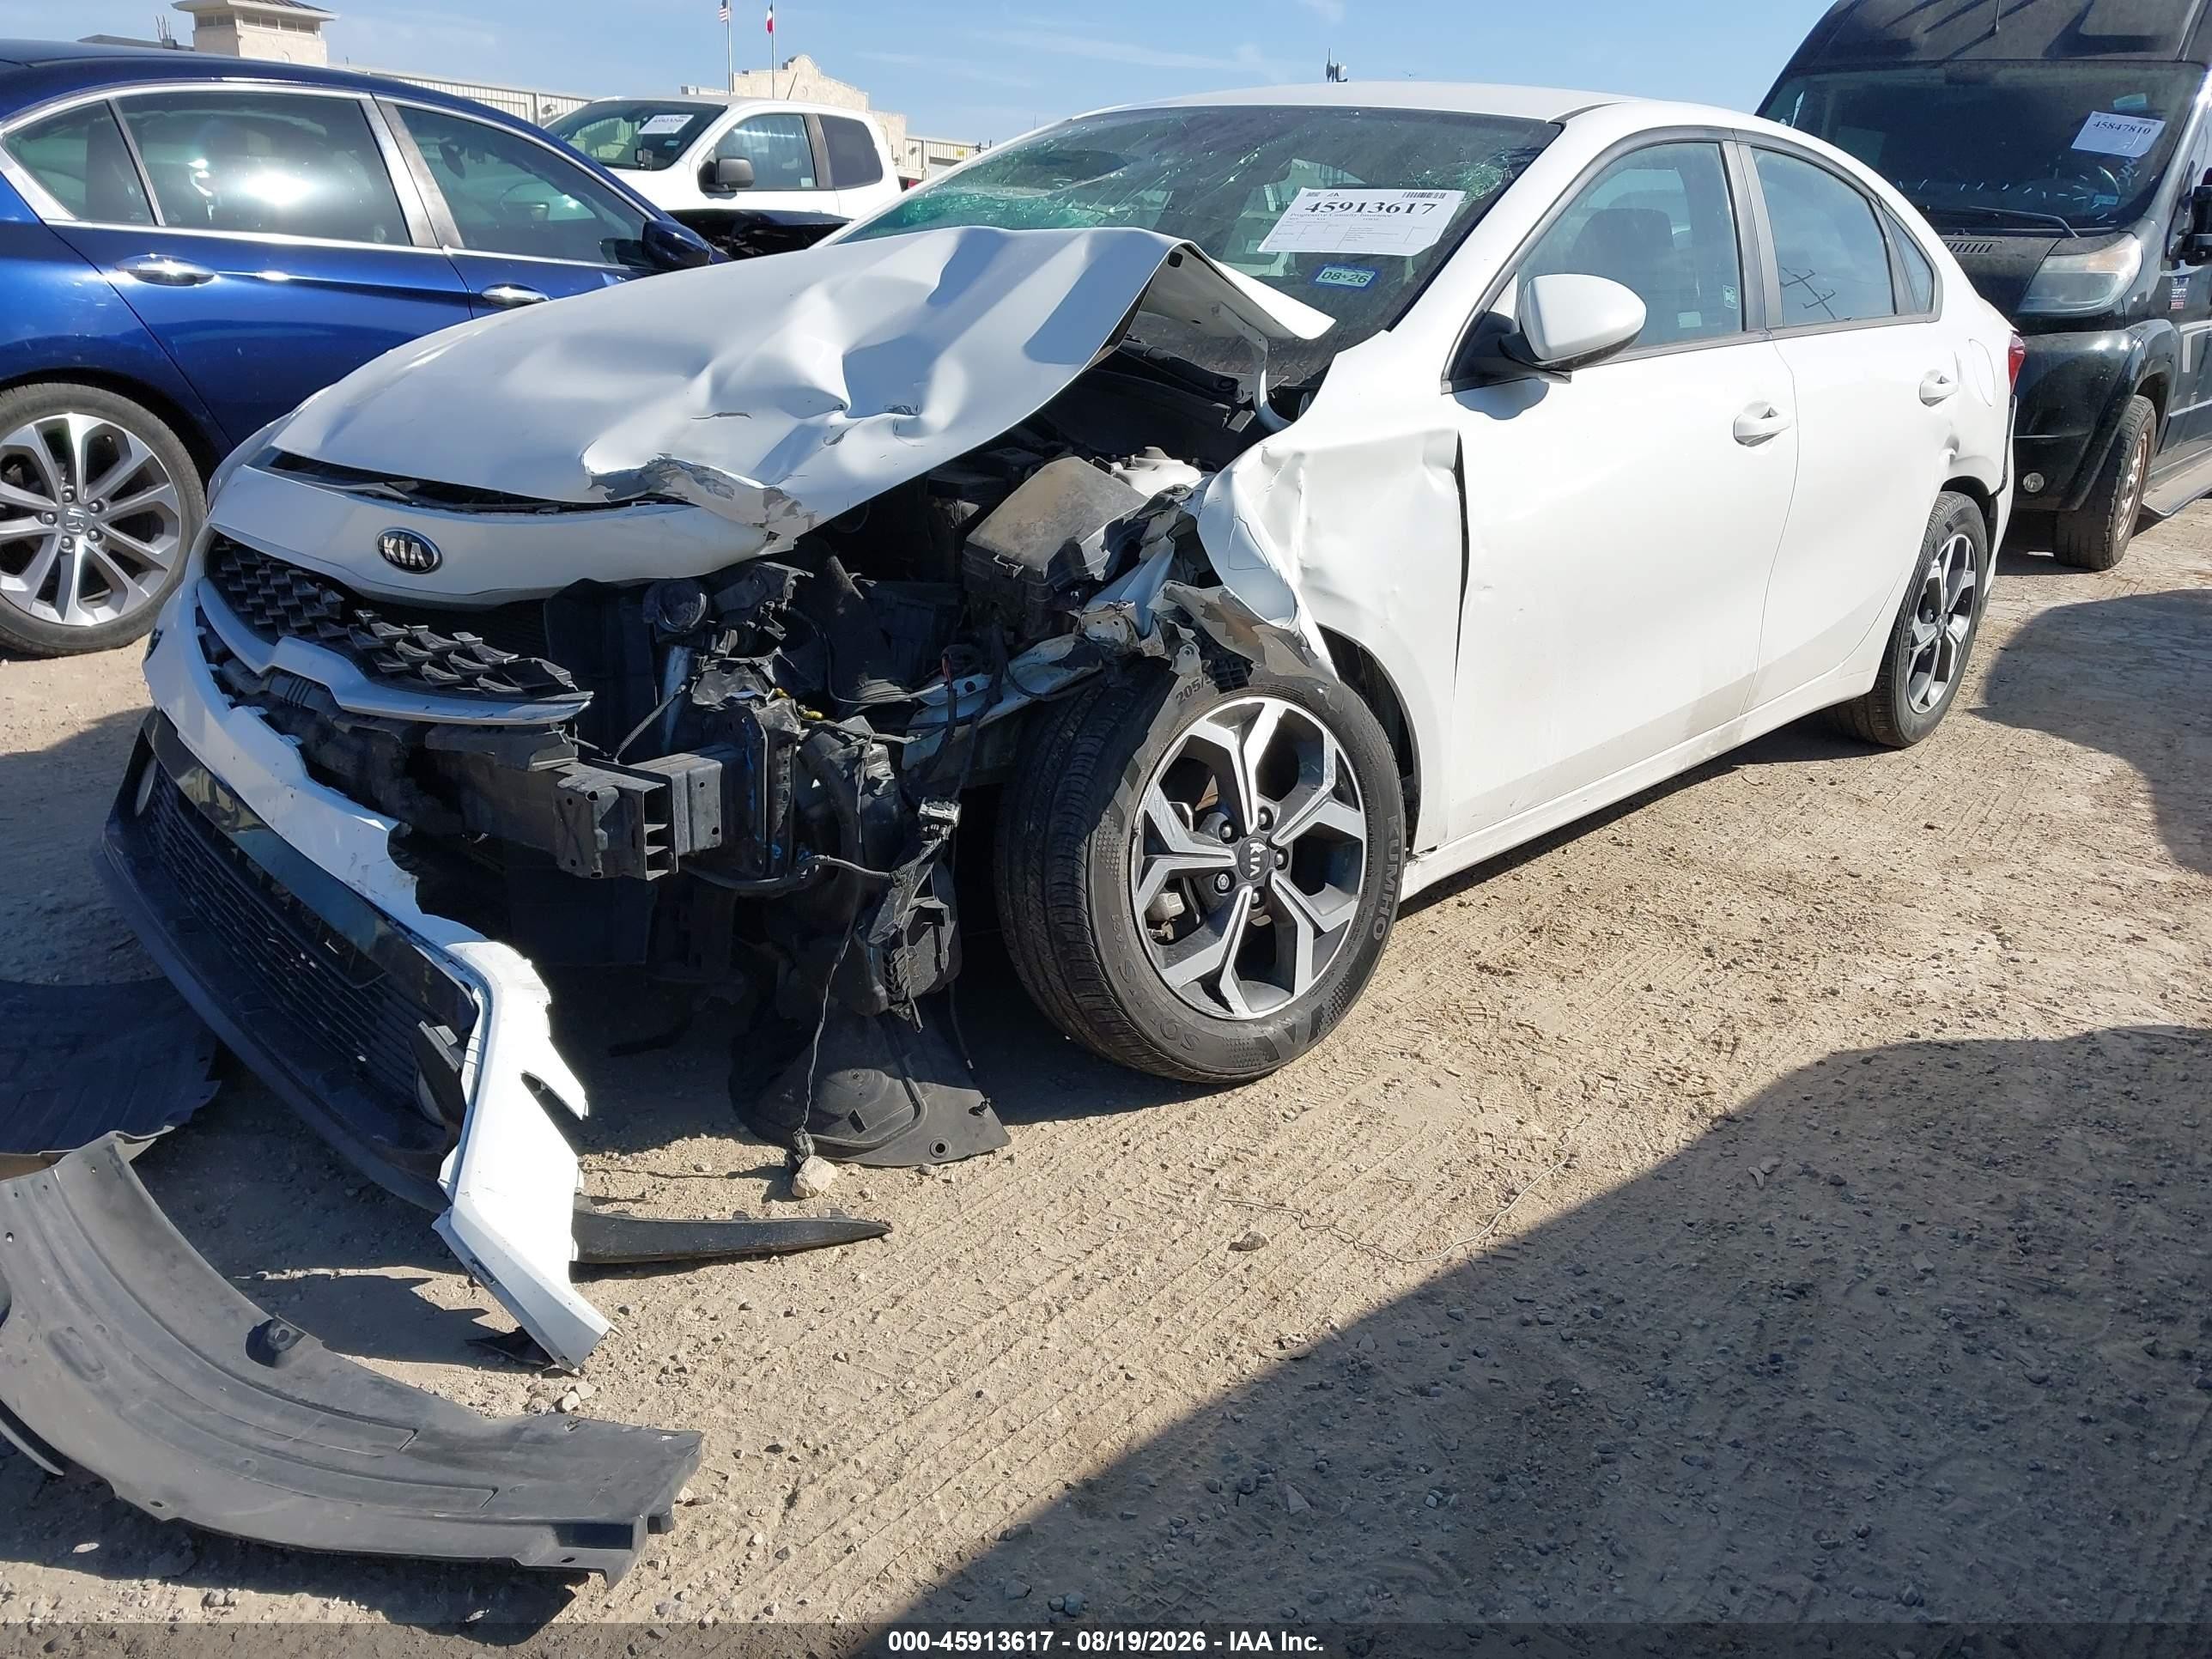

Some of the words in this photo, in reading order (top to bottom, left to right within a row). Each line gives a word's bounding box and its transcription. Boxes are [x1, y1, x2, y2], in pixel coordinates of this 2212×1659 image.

[2093, 121, 2151, 136] 45847810
[1304, 201, 1439, 215] 45913617
[383, 535, 428, 568] KIA
[1249, 842, 1267, 877] KIA
[1373, 816, 1400, 940] KUMHO
